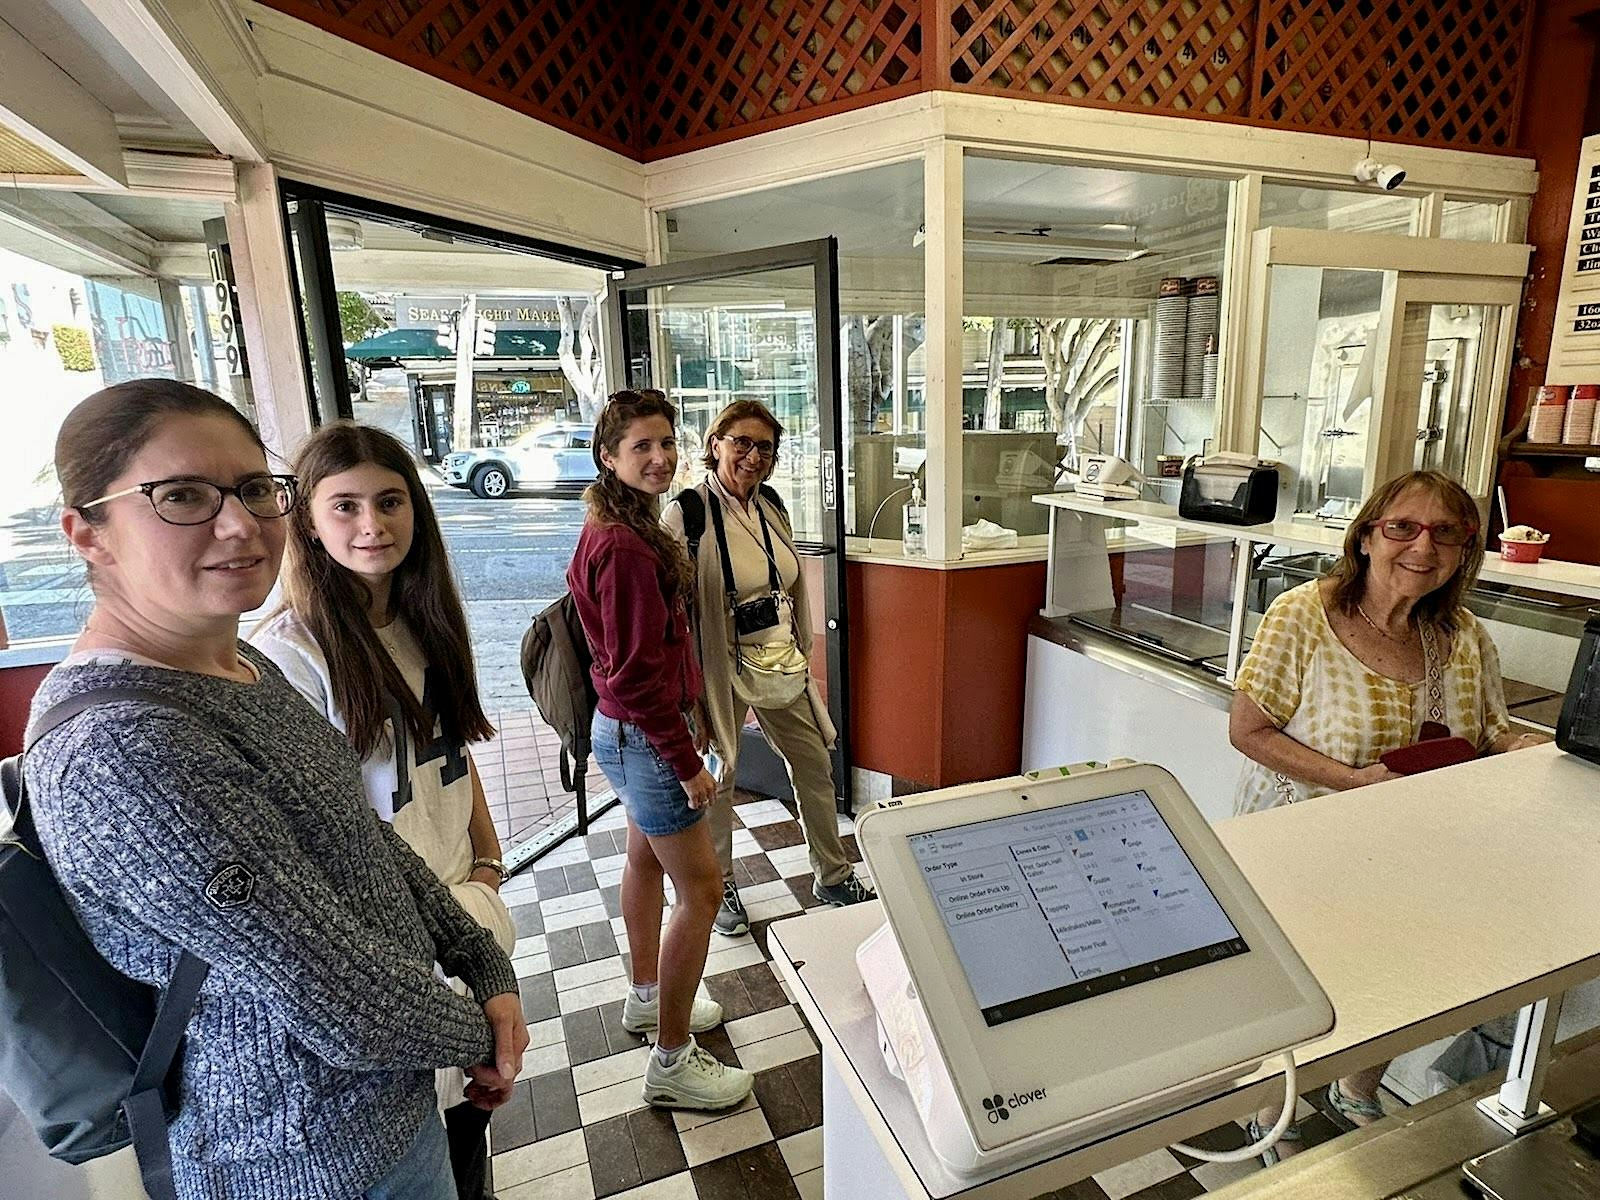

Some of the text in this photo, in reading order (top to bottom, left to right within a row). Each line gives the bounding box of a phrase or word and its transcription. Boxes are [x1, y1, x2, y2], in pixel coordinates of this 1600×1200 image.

[211, 251, 238, 373] 1999
[516, 307, 578, 321] MARKT
[825, 456, 834, 504] PUSH
[924, 861, 959, 873] Order Type
[967, 873, 985, 881] Store
[948, 884, 1011, 903] Online Order Pick Up
[955, 900, 1019, 920] Online Order Delivery
[1008, 1088, 1047, 1109] clover
